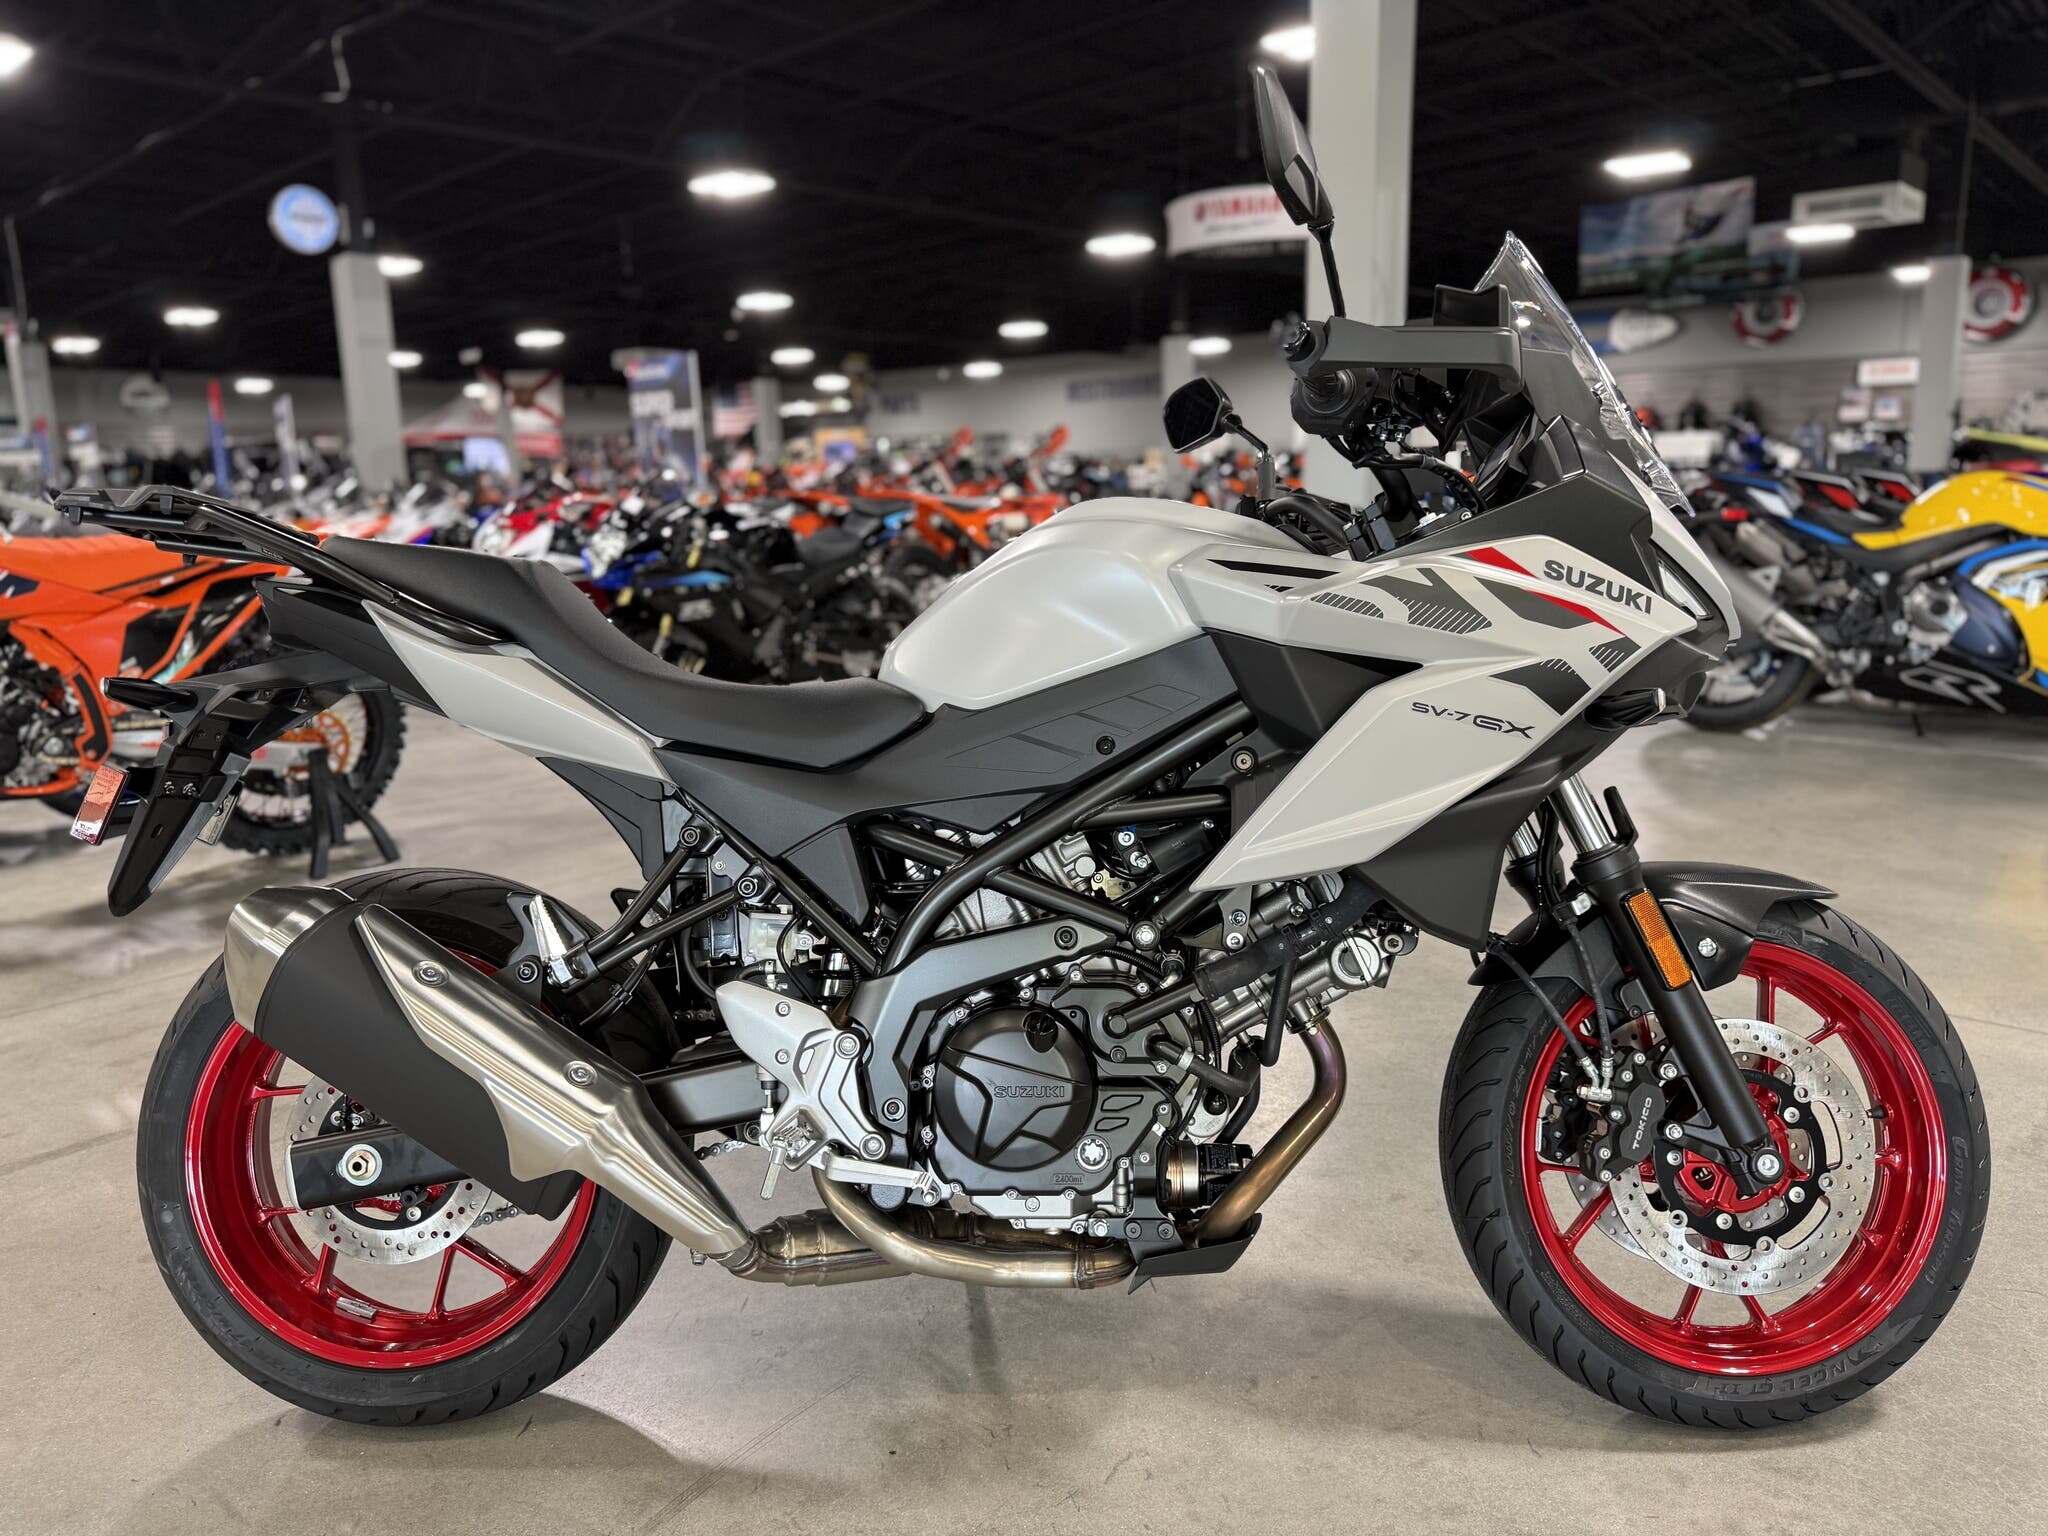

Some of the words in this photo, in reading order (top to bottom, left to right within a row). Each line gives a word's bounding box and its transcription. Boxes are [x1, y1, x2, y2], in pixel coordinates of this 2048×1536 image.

[1543, 559, 1653, 615] SUZUKI
[1411, 701, 1535, 740] SV-7GX
[994, 1085, 1065, 1098] SUZUKI
[1632, 1097, 1653, 1150] TOKICO
